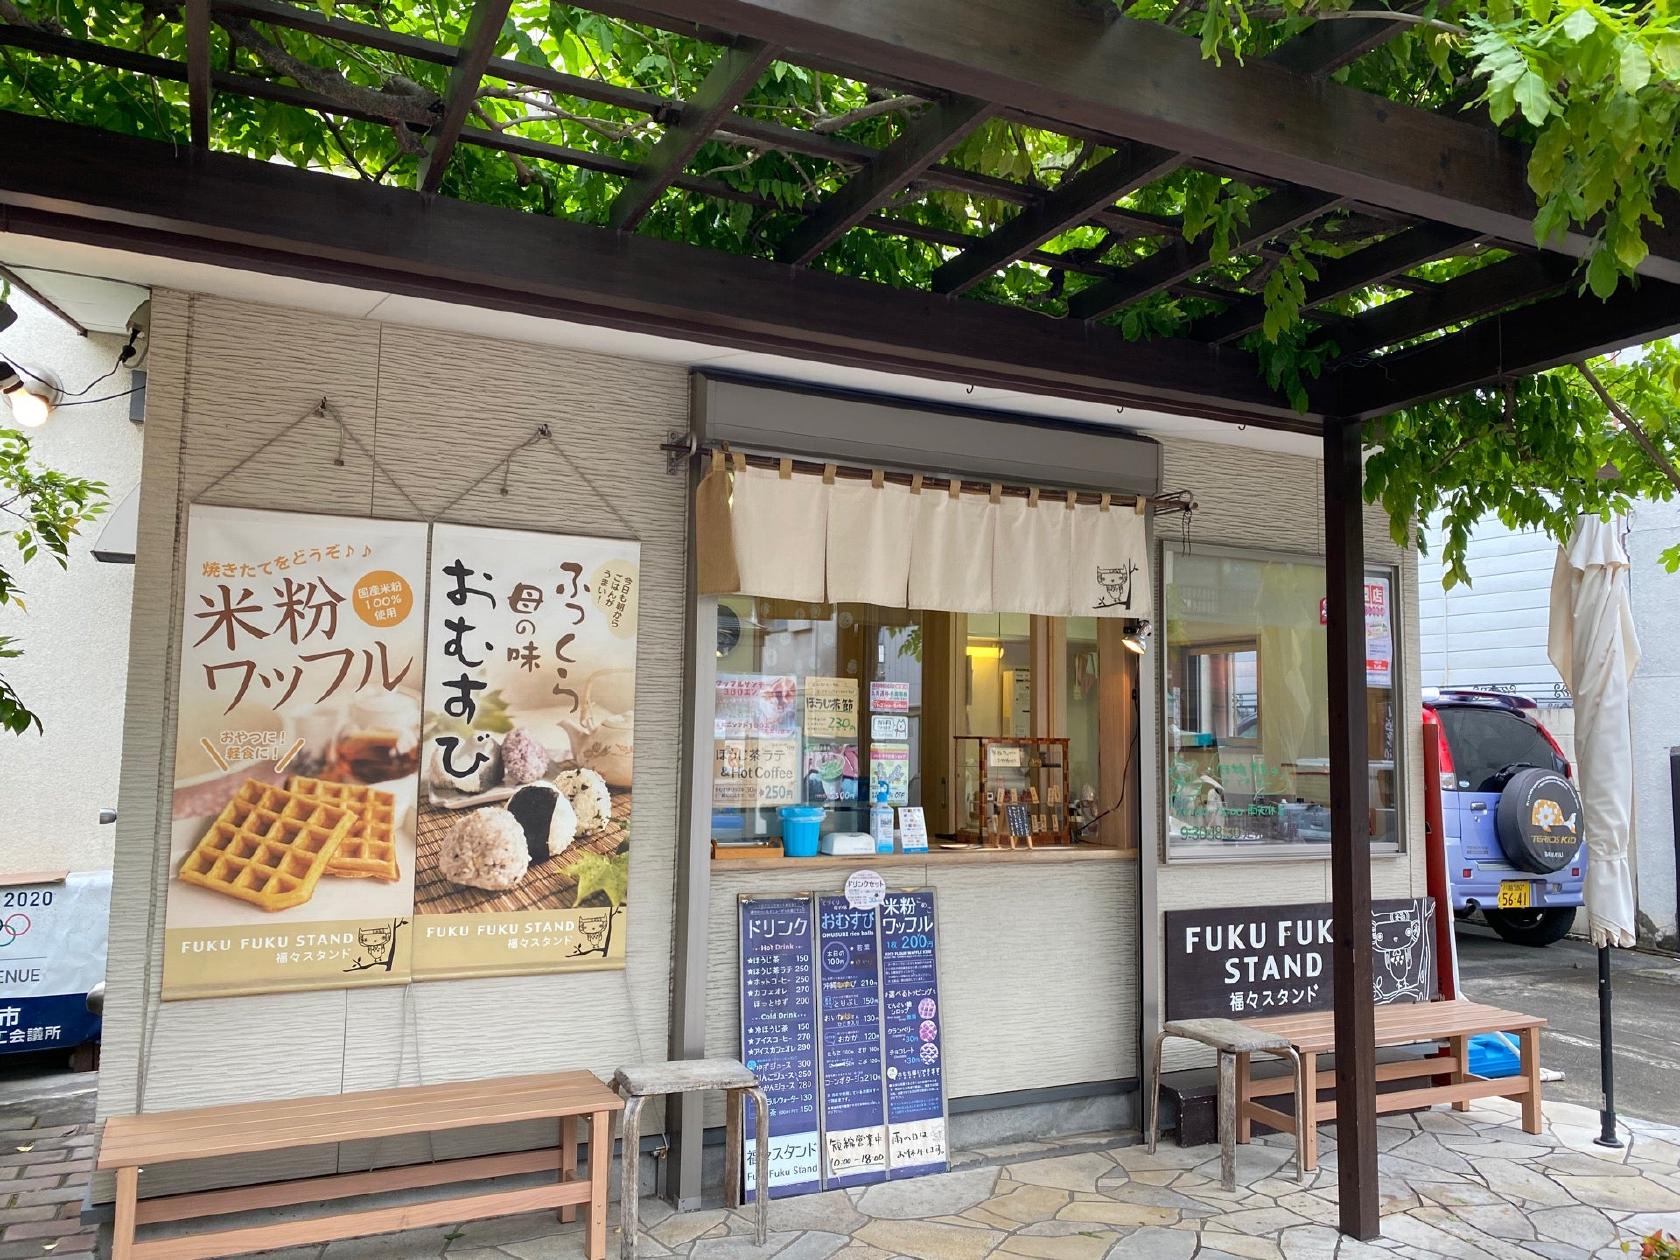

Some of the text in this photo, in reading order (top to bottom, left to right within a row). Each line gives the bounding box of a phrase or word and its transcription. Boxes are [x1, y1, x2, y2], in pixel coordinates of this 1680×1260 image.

[358, 581, 402, 598] 国産米粉
[365, 595, 402, 610] 100%
[193, 576, 347, 651] 米粉
[374, 609, 397, 622] 使用
[507, 582, 543, 673] 母の味
[553, 561, 591, 714] ふっくら
[435, 558, 497, 778] おむすび
[202, 640, 414, 716] ワッフル
[755, 766, 793, 779] Coffee
[4, 892, 53, 908] 2020
[884, 897, 916, 916] 米粉
[426, 920, 575, 938] FUKU FUKU STAND
[749, 917, 808, 939] ドリンク
[821, 911, 875, 930] おむすび
[882, 915, 934, 935] ワッフル
[181, 932, 354, 953] FUKU FUKU STAND
[507, 935, 573, 950] 福々スタンド
[1185, 918, 1334, 954] FUKU FUK
[276, 948, 352, 964] 福々スタンド
[796, 954, 809, 962] 150
[1224, 952, 1323, 984] STAND
[1229, 983, 1319, 1012] 福々スタンド
[778, 1011, 798, 1019] Drink
[759, 1082, 796, 1092] かんジュース
[769, 1164, 791, 1178] Fuku
[793, 1163, 818, 1176] Stand
